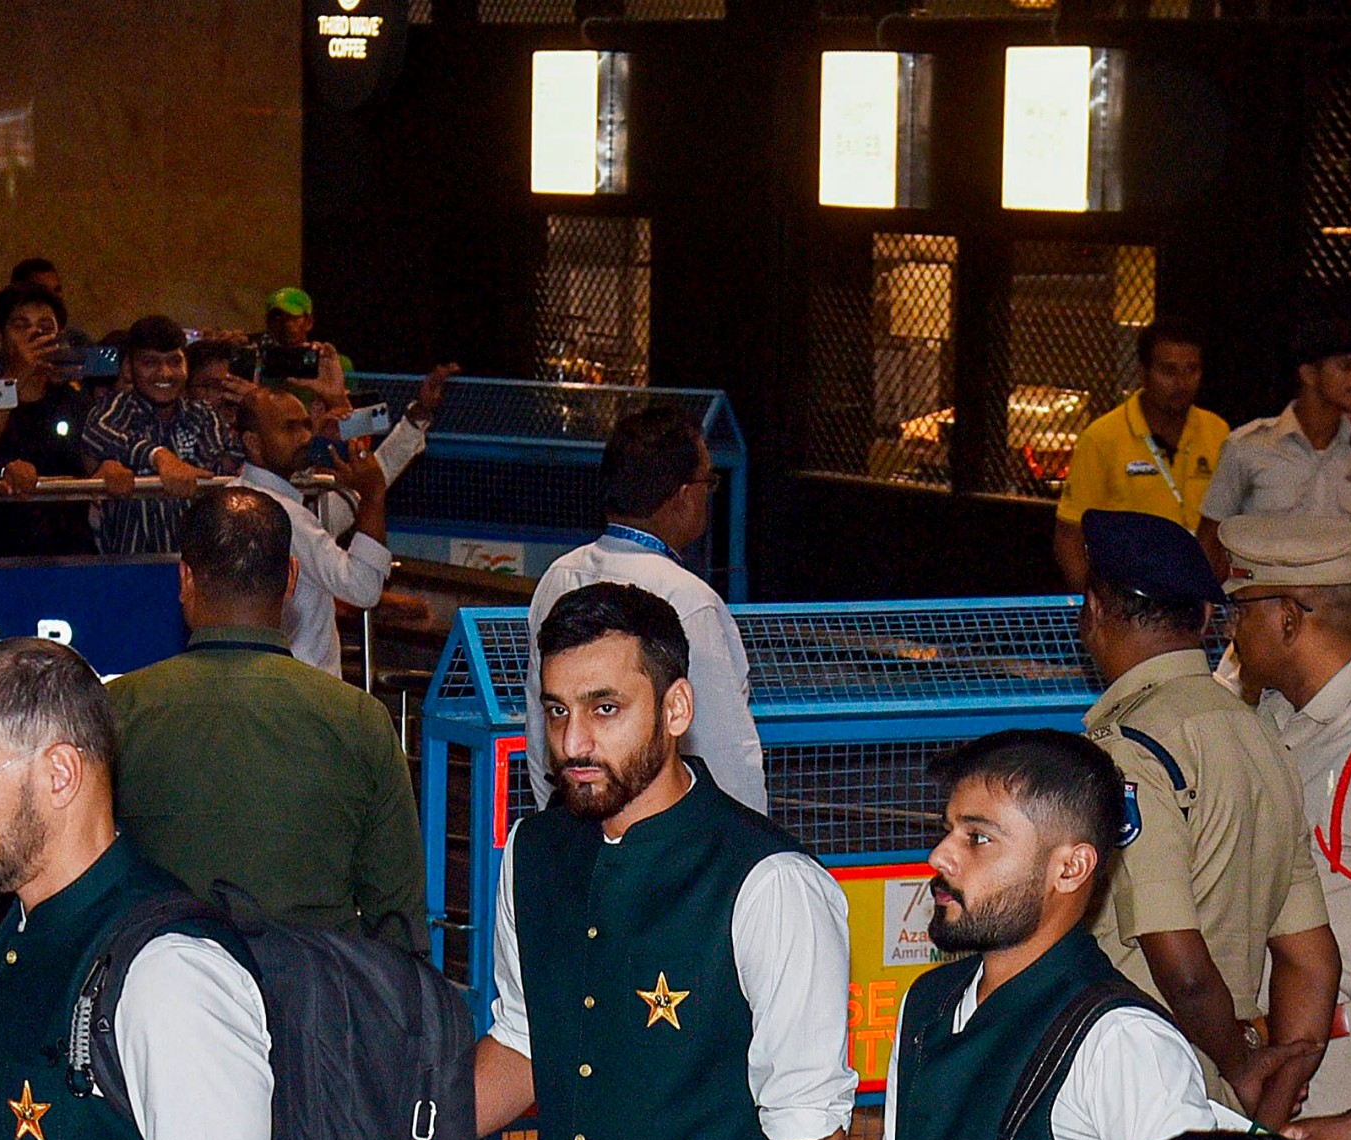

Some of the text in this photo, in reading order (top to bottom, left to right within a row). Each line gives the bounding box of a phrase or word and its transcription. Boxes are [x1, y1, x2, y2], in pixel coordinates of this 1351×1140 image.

[317, 15, 349, 36] THIRD
[329, 37, 367, 59] COFFEE
[891, 946, 928, 960] Amrit
